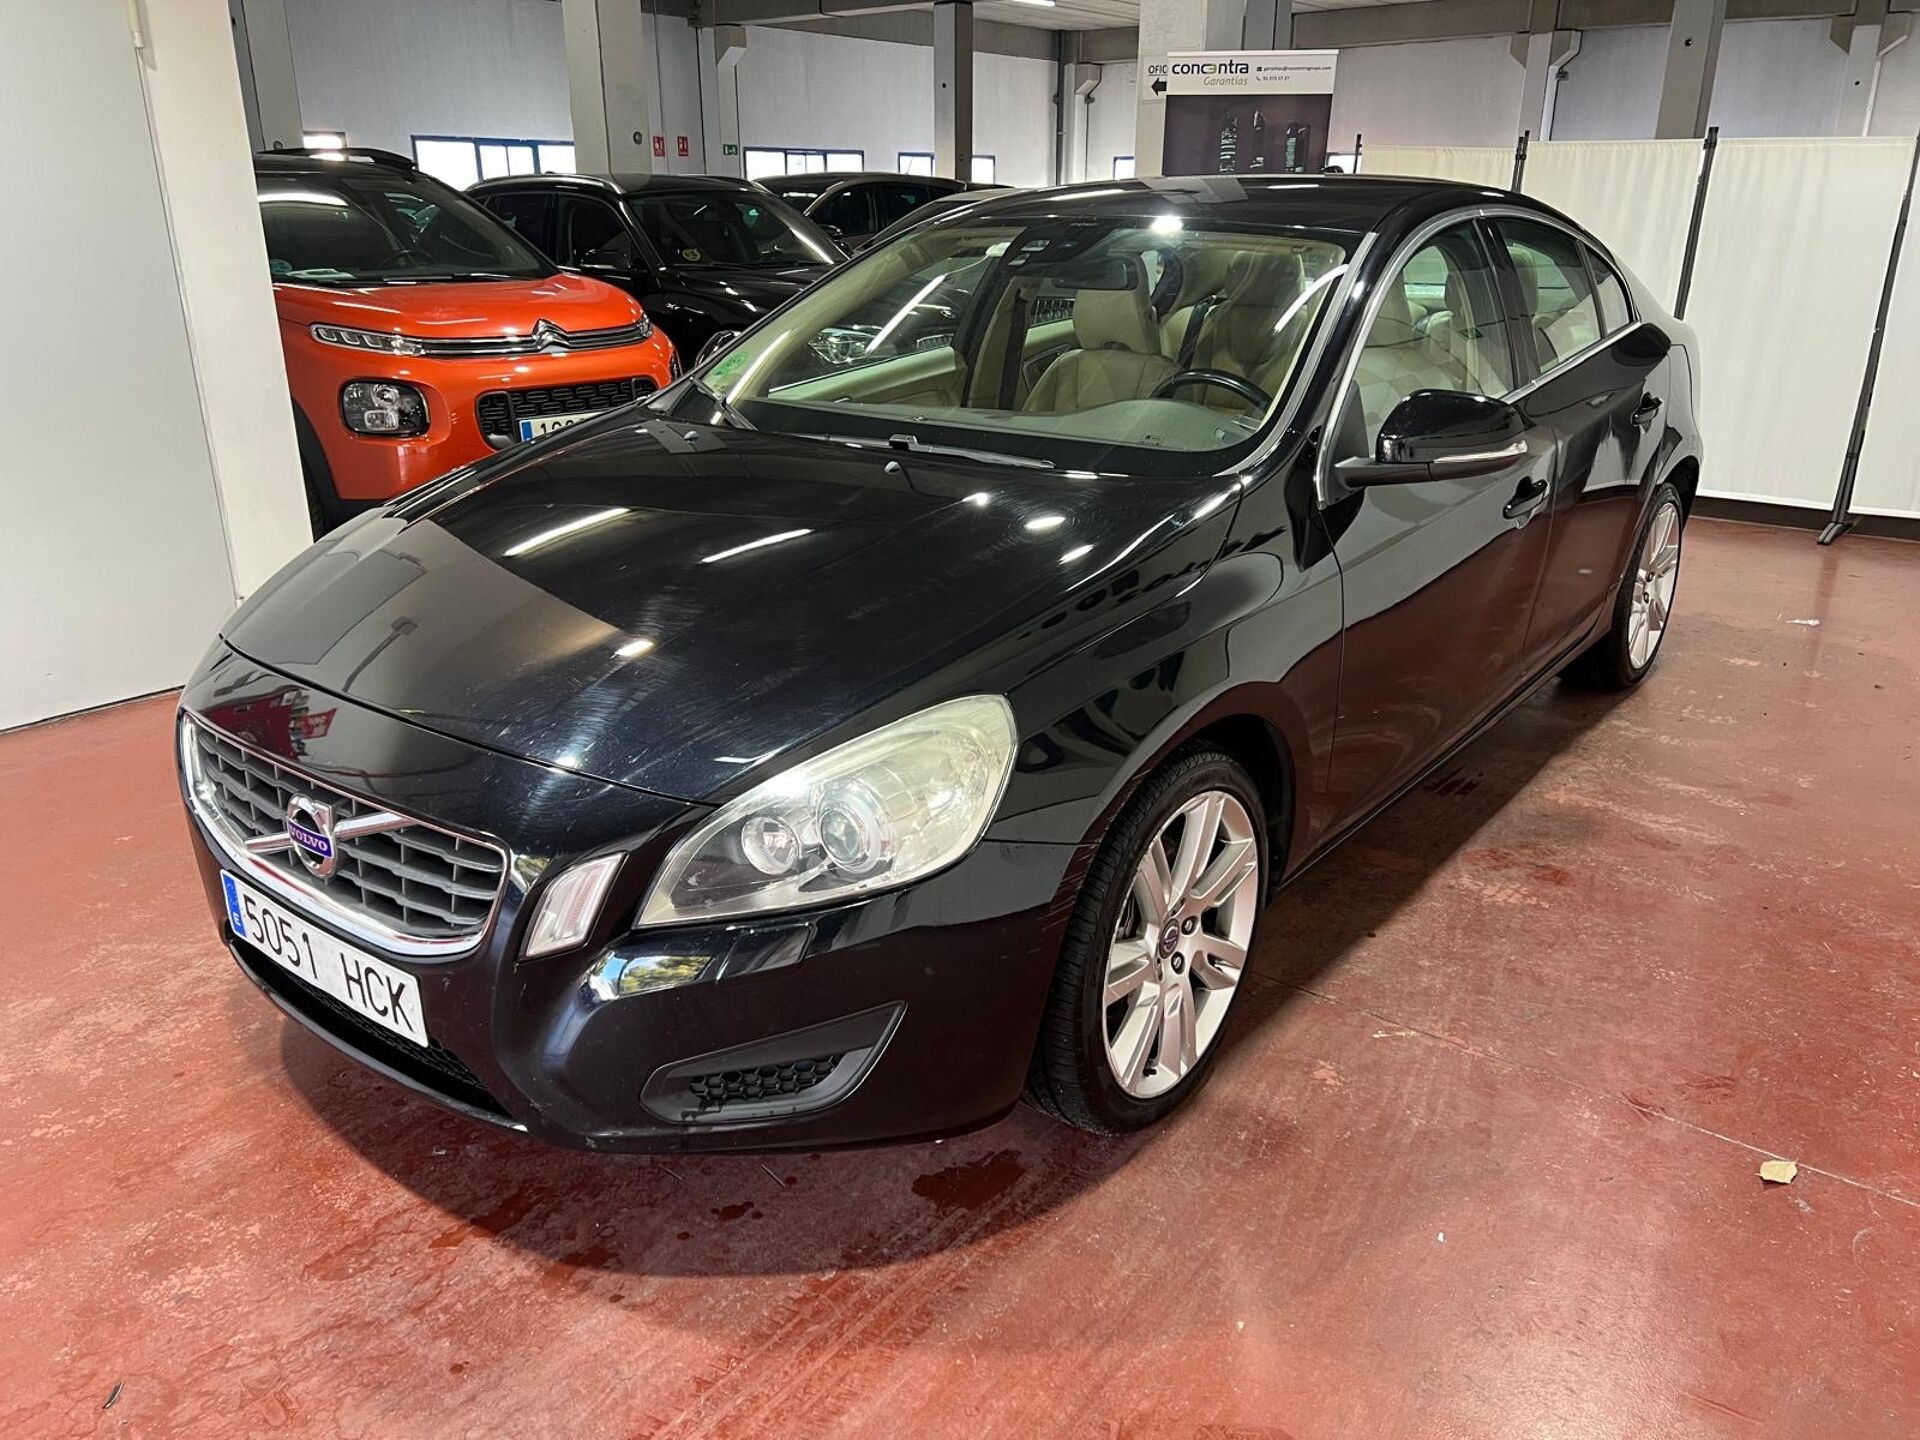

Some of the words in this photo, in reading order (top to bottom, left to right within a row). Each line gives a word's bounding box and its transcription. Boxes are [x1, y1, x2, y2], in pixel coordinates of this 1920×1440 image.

[1171, 59, 1249, 75] concentra
[289, 824, 329, 852] VOLVO
[242, 893, 319, 980] 5051
[340, 952, 414, 1033] HCK
